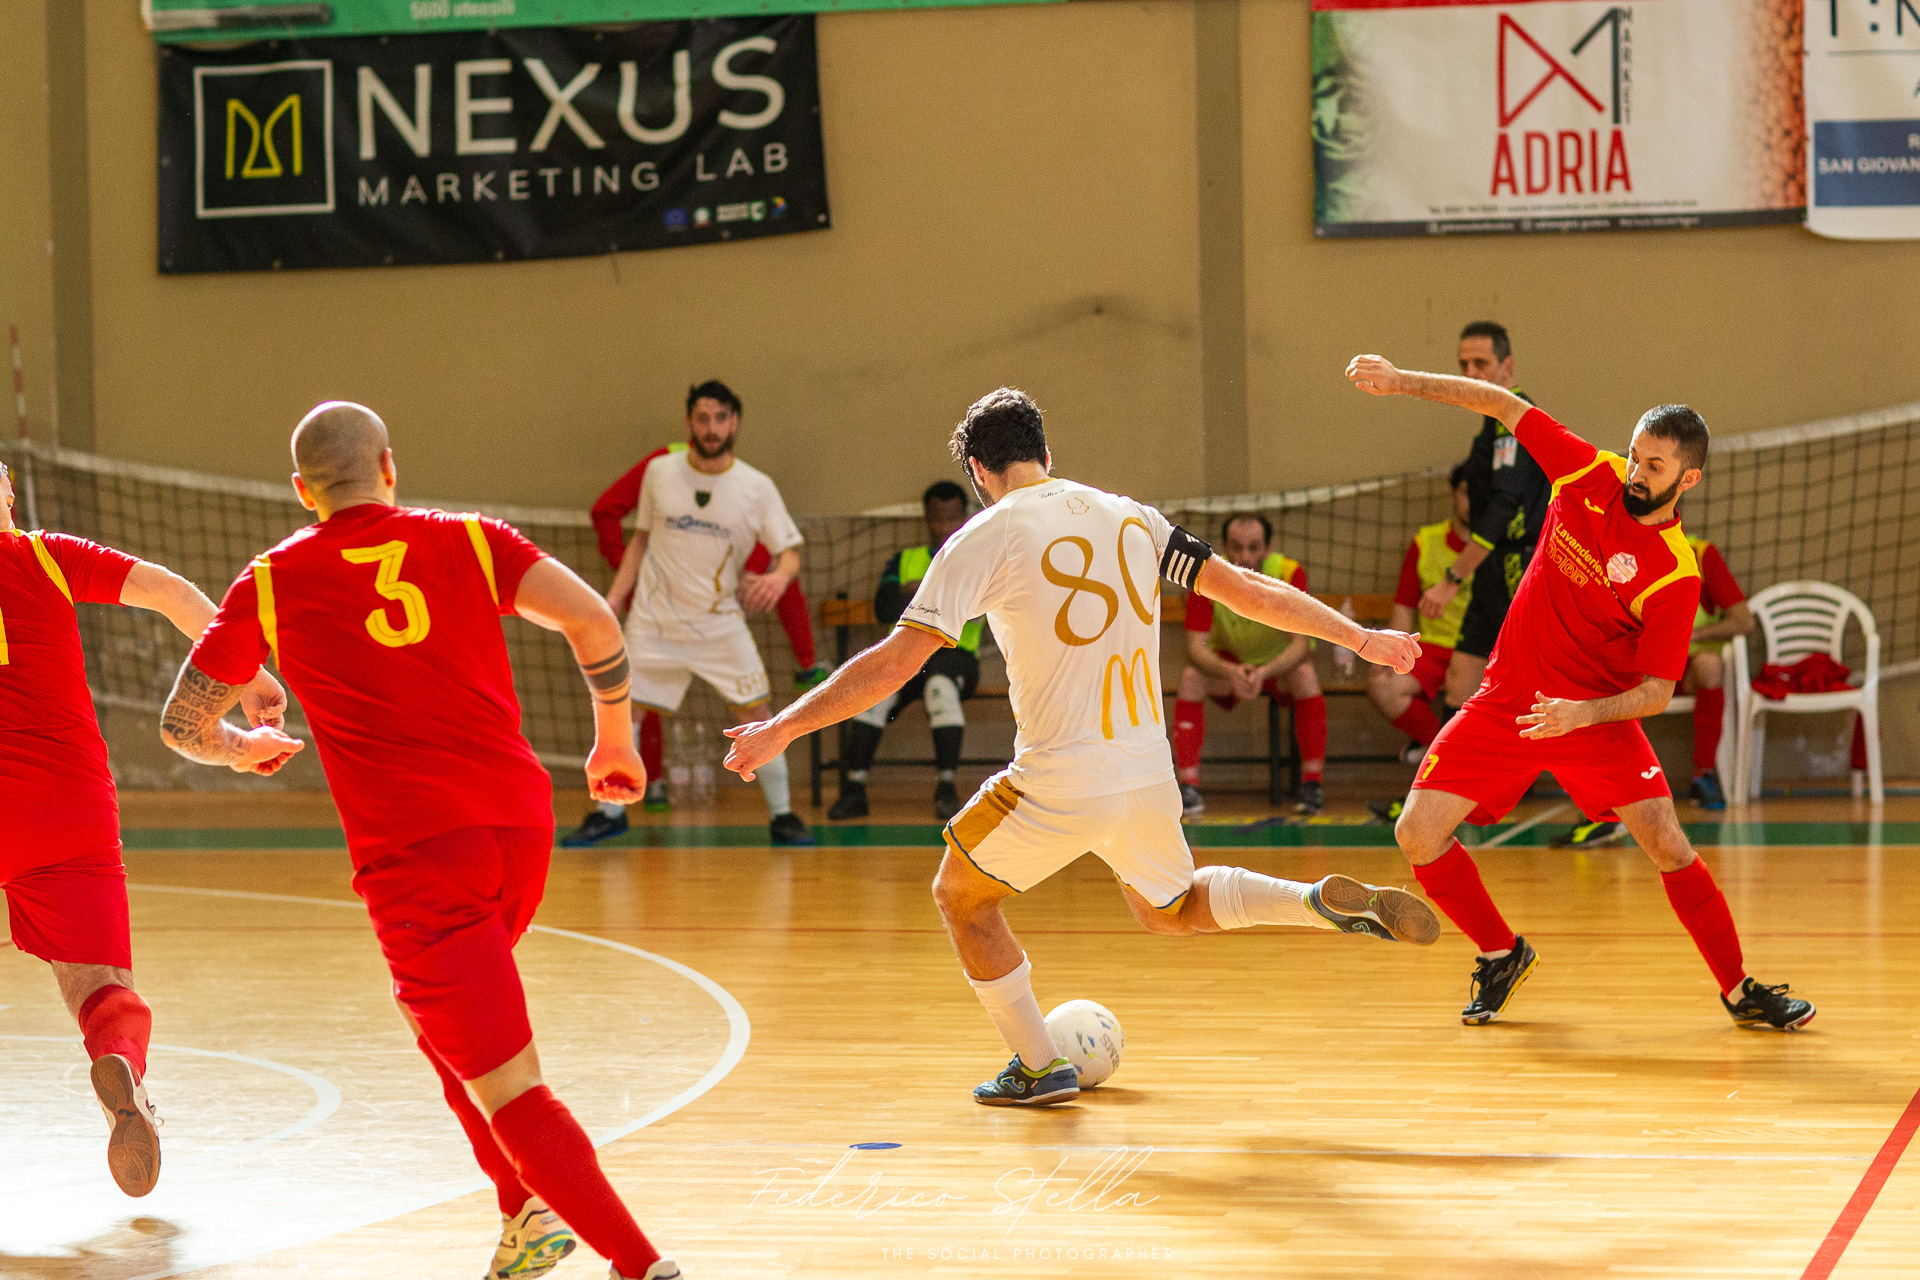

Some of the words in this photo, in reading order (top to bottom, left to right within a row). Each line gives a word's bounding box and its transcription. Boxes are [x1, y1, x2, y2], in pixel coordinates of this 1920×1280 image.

[357, 36, 786, 161] NEXUS
[357, 162, 661, 207] MARKETING
[695, 143, 789, 182] LAB
[1491, 128, 1633, 197] ADRIA
[1817, 157, 1854, 175] SAN
[1556, 522, 1602, 573] Lavanderie
[341, 540, 431, 648] 3
[1041, 517, 1161, 647] 80
[1422, 754, 1440, 780] 7
[1100, 1033, 1120, 1076] EMS
